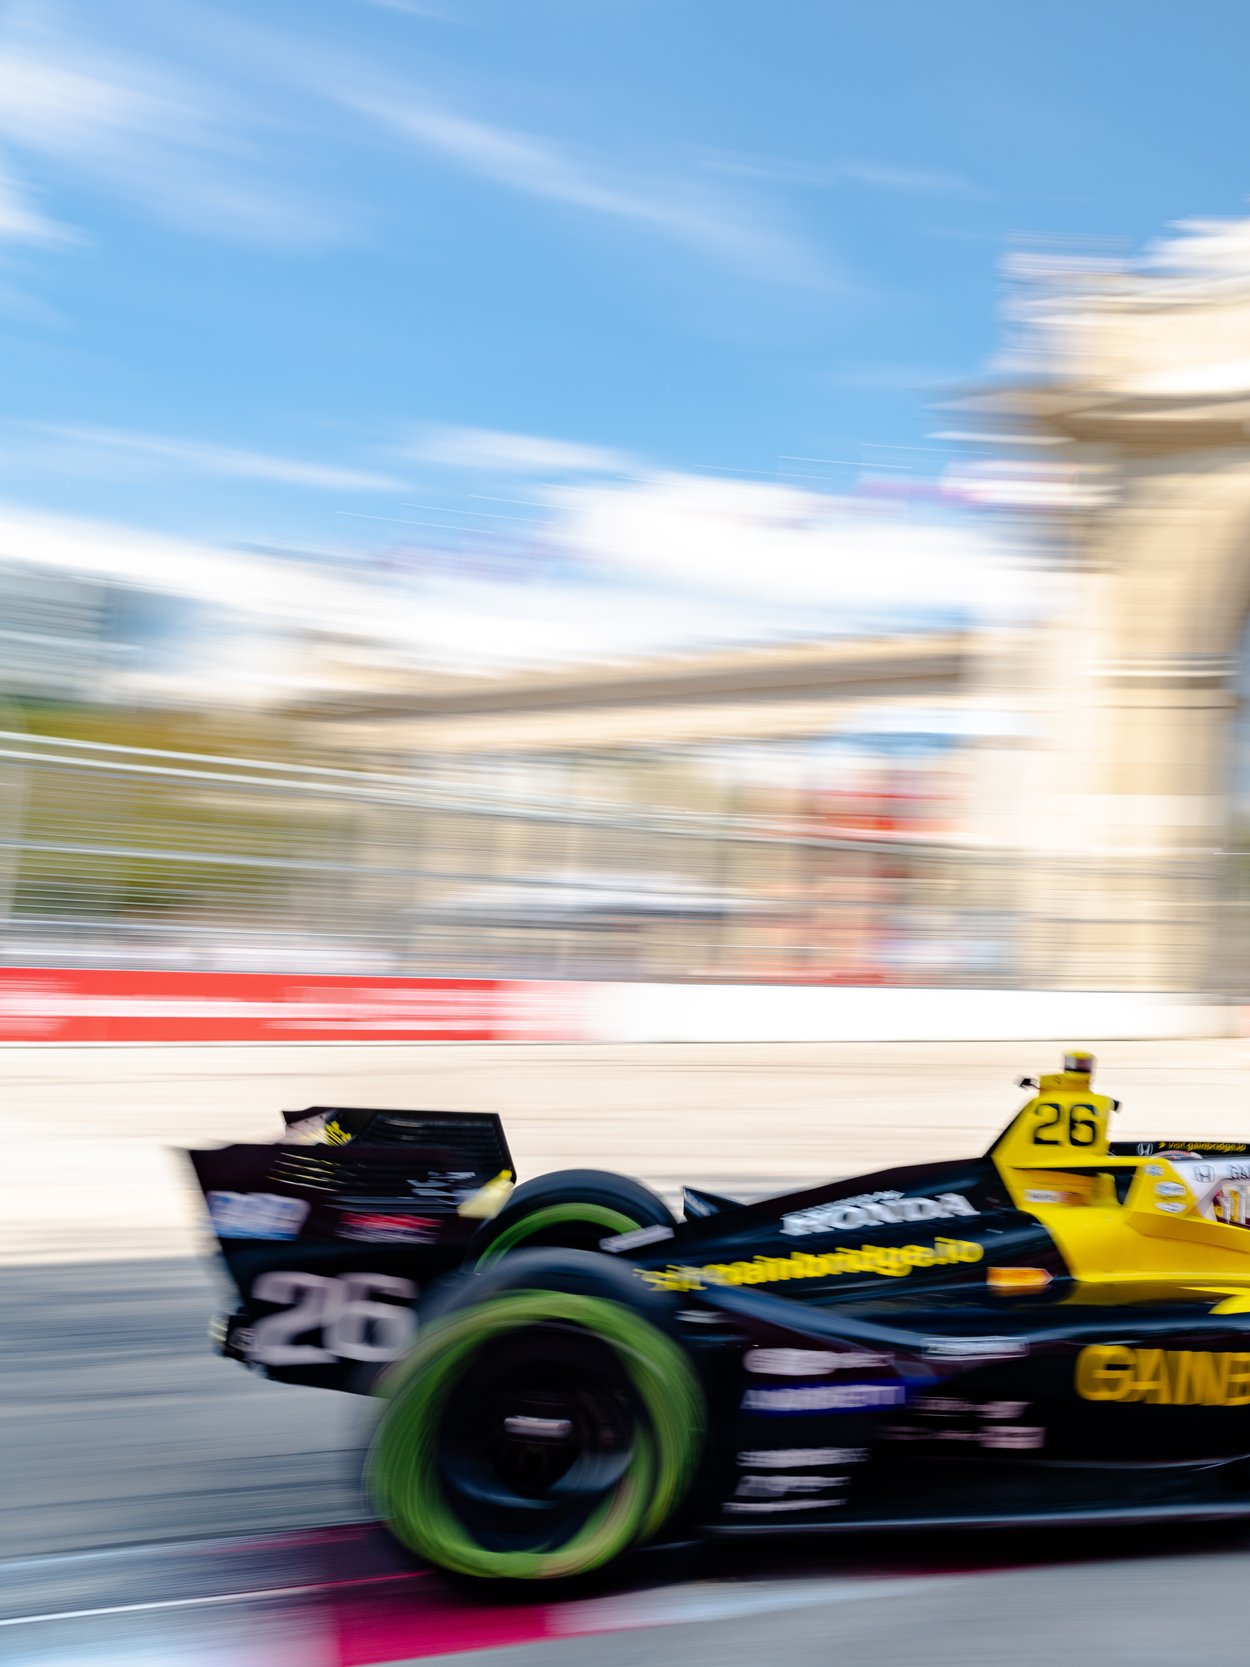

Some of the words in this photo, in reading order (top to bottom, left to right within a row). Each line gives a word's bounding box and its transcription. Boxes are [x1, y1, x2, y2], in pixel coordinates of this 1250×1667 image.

[1034, 1103, 1096, 1146] 26
[779, 1192, 981, 1236] HONDA
[251, 1271, 419, 1366] 26
